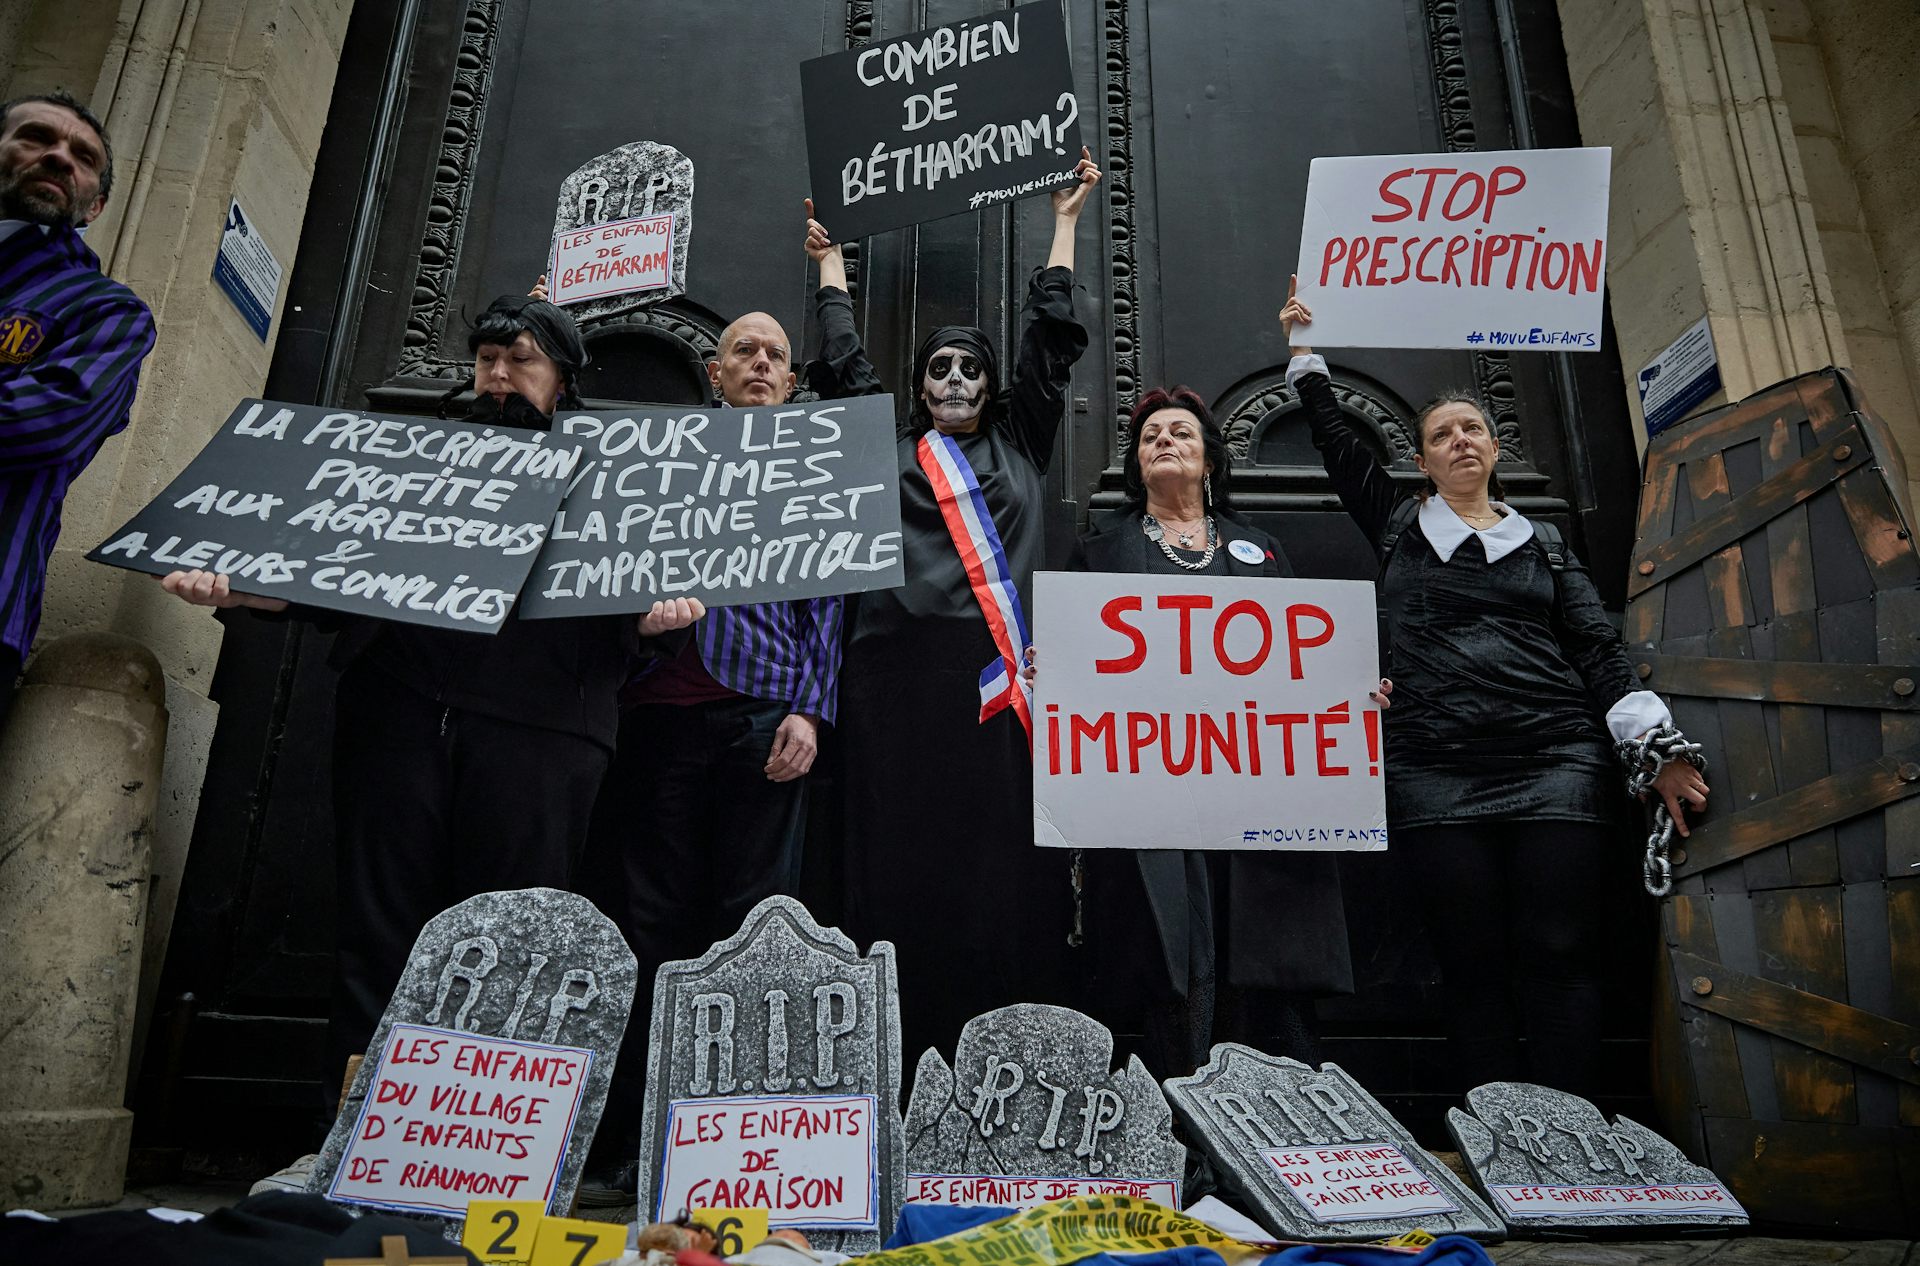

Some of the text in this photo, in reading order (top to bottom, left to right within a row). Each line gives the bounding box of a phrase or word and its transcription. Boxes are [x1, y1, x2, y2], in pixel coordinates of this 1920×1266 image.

[902, 83, 958, 131] DE
[1372, 165, 1526, 224] STOP
[564, 221, 669, 250] LES ENFANTS
[595, 244, 627, 258] DE
[561, 252, 667, 288] BÉTHARRAM
[234, 403, 295, 441] LA
[563, 406, 845, 457] POUR LES
[174, 484, 547, 555] AUX AGRESSEURS
[551, 509, 607, 542] LA
[781, 484, 885, 526] EST
[102, 531, 306, 583] A LEURS
[315, 539, 376, 563] &
[1096, 595, 1335, 680] STOP
[1243, 828, 1388, 843] #MOUVENFANTS
[391, 1038, 577, 1088] LES ENFANTS
[377, 1078, 418, 1105] DU
[675, 1107, 862, 1147] LES ENFANTS
[348, 1157, 389, 1184] DE
[739, 1149, 780, 1173] DE
[1271, 1148, 1402, 1168] LES ENFANTS
[1282, 1161, 1412, 1187] DU COLLEGE
[949, 1178, 1038, 1204] ENFANTS
[1043, 1183, 1080, 1200] DE
[1505, 1187, 1543, 1202] LES
[1548, 1188, 1616, 1203] ENFANTS
[1616, 1188, 1643, 1203] DE
[487, 1210, 520, 1254] 2
[565, 1232, 599, 1266] 7
[717, 1217, 743, 1257] 6
